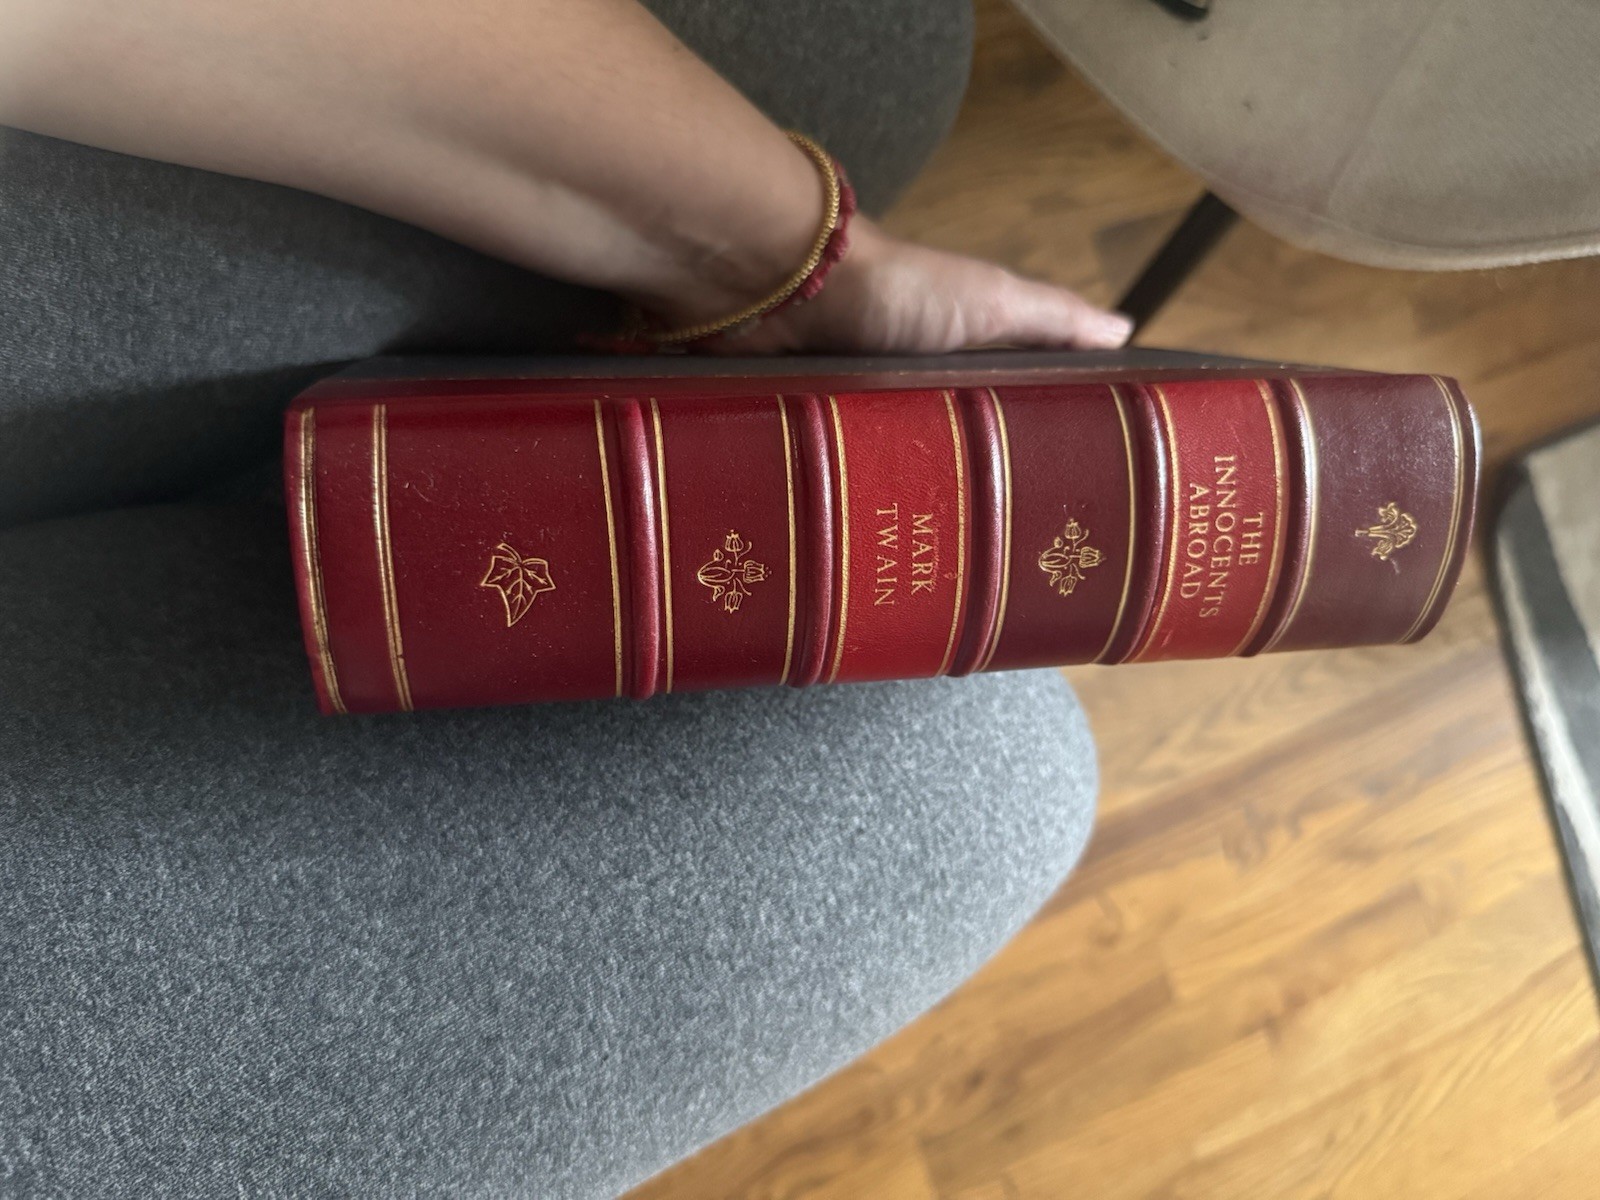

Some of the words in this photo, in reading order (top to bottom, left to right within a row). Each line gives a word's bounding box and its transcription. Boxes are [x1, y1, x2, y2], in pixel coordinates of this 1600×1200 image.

[873, 502, 899, 607] TWAIN
[911, 513, 934, 595] MARK
[1180, 482, 1211, 599] ABROAD
[1199, 454, 1238, 618] INNOCENTS
[1238, 511, 1264, 566] THE
